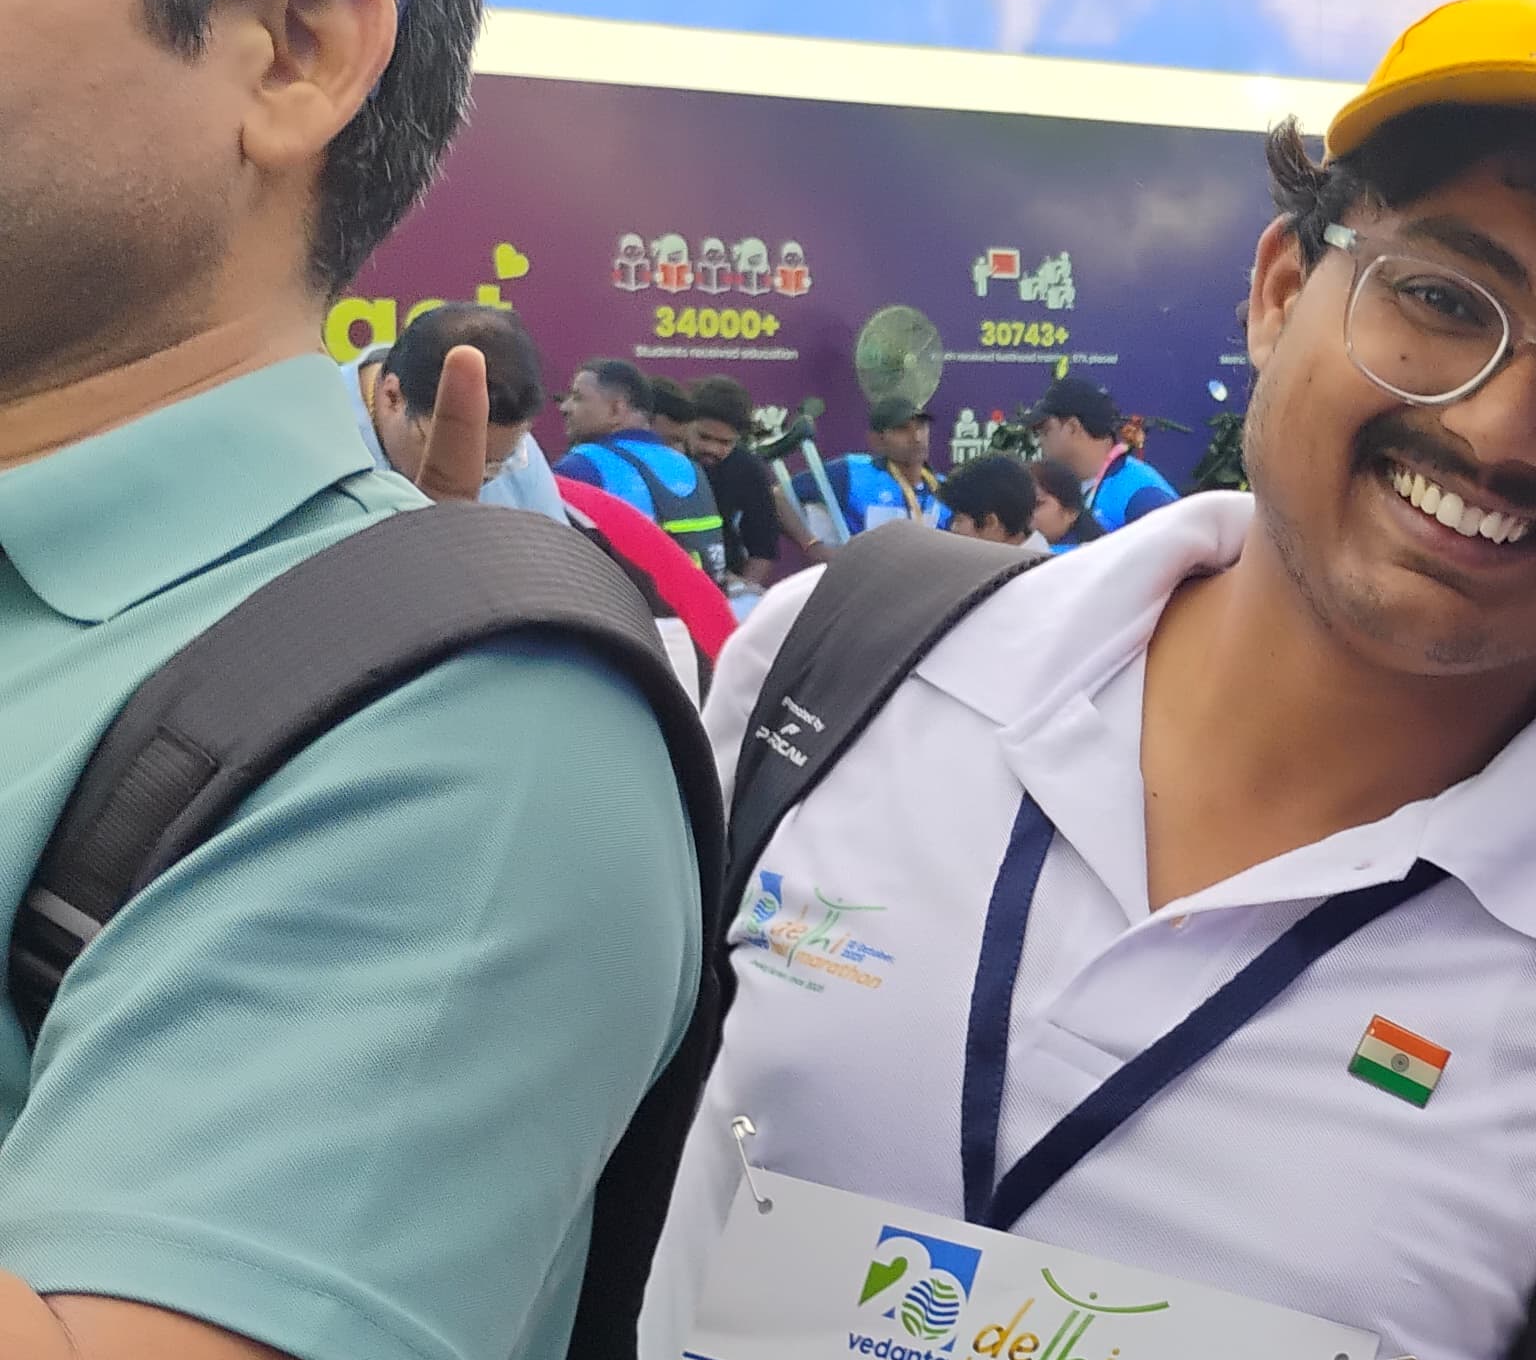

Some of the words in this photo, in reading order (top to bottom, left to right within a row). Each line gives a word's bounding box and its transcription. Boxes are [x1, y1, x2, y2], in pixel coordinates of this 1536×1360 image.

[655, 305, 781, 340] 34000+
[980, 320, 1069, 347] 30743+
[635, 345, 689, 358] Students
[690, 347, 740, 359] received
[741, 348, 799, 361] education
